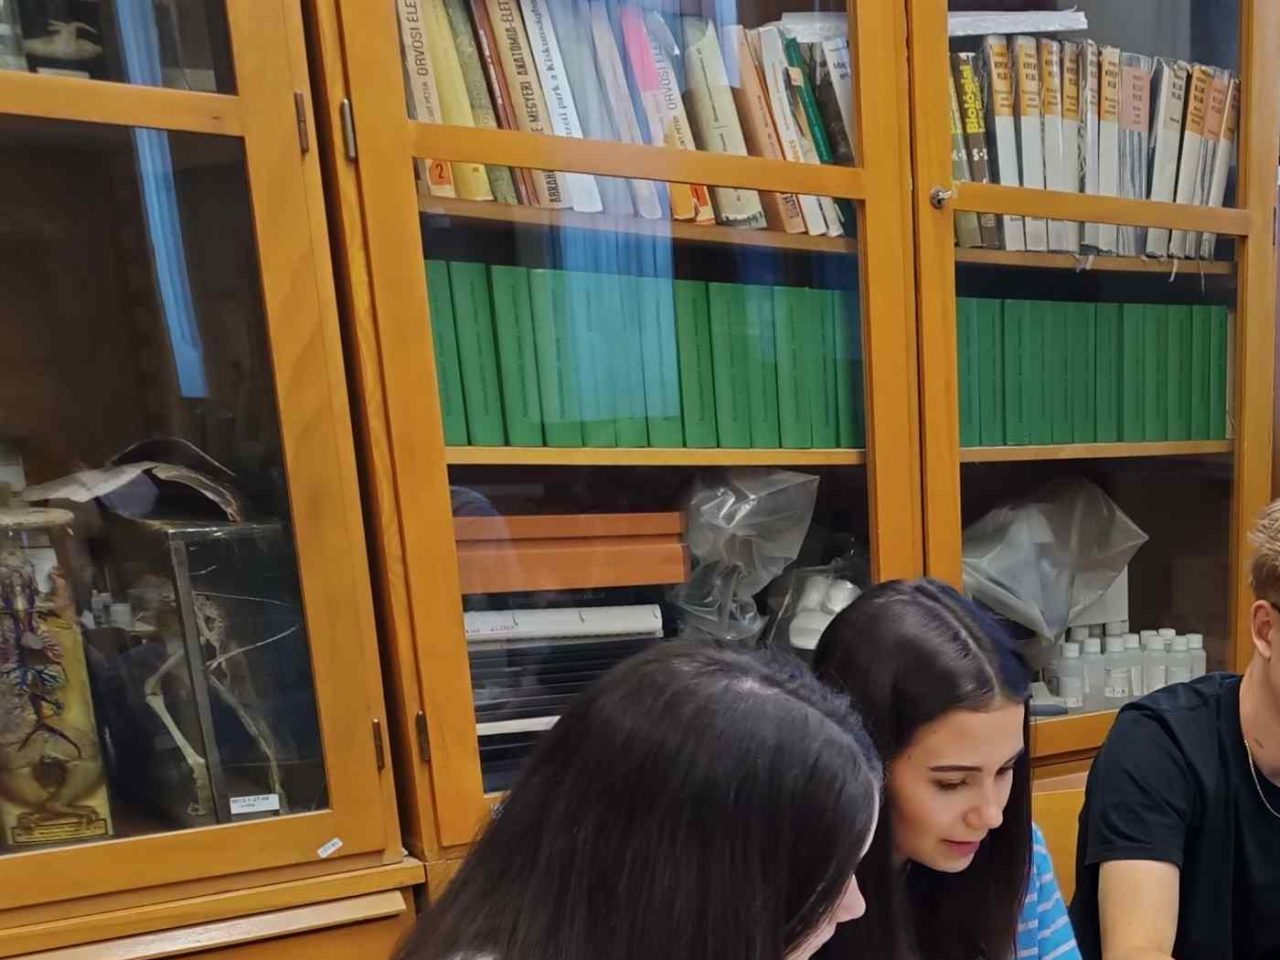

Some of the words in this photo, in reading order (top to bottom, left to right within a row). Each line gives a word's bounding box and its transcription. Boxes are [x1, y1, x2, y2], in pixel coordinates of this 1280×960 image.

[410, 27, 429, 76] ORVOSI
[520, 80, 543, 123] MEGYERI
[435, 163, 446, 180] 2
